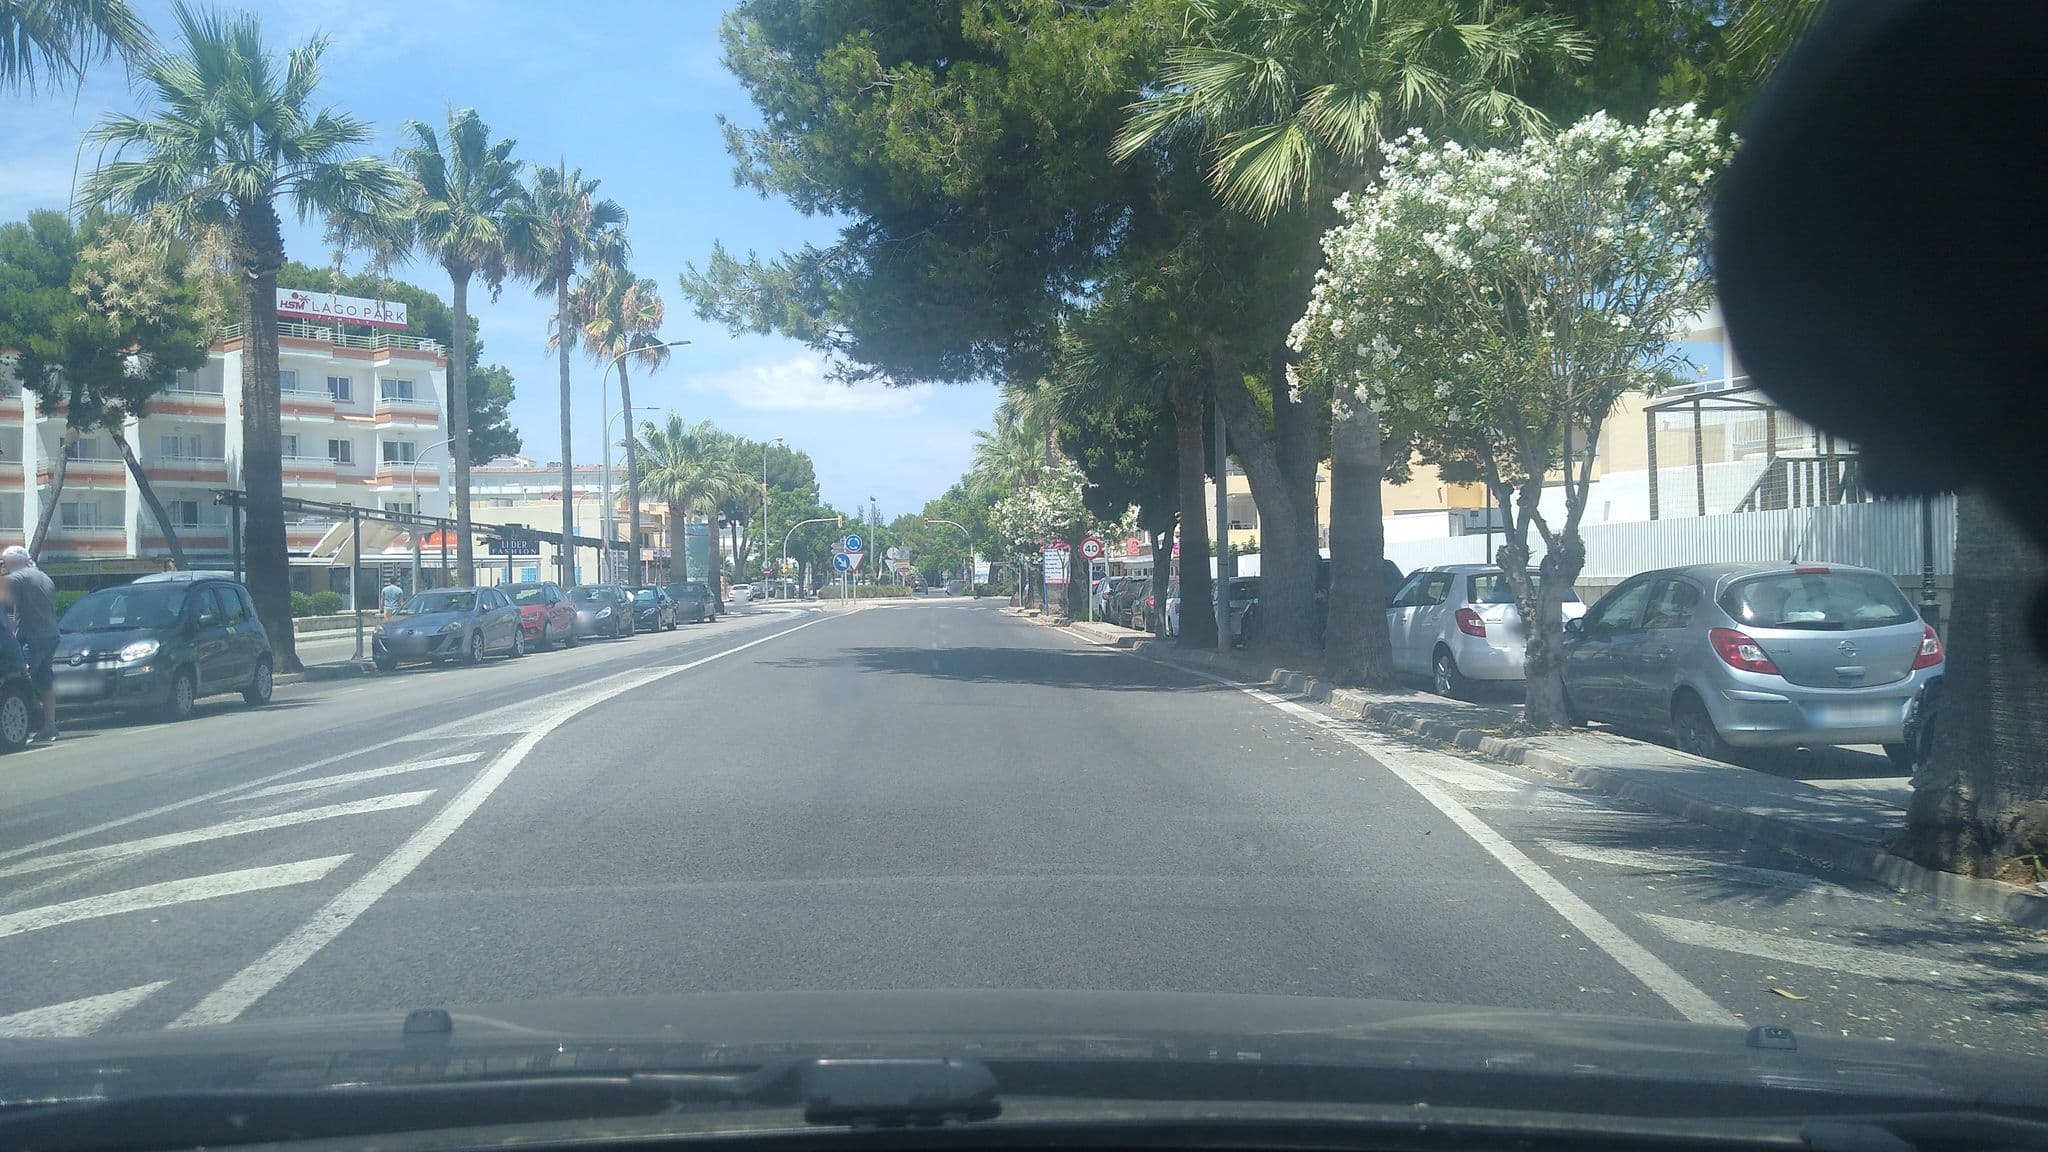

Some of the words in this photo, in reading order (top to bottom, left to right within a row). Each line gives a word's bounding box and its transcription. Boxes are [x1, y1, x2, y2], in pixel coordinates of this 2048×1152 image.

[280, 299, 305, 311] HSM
[312, 301, 357, 316] LAGO
[363, 307, 405, 322] PARK
[1085, 545, 1098, 553] 40
